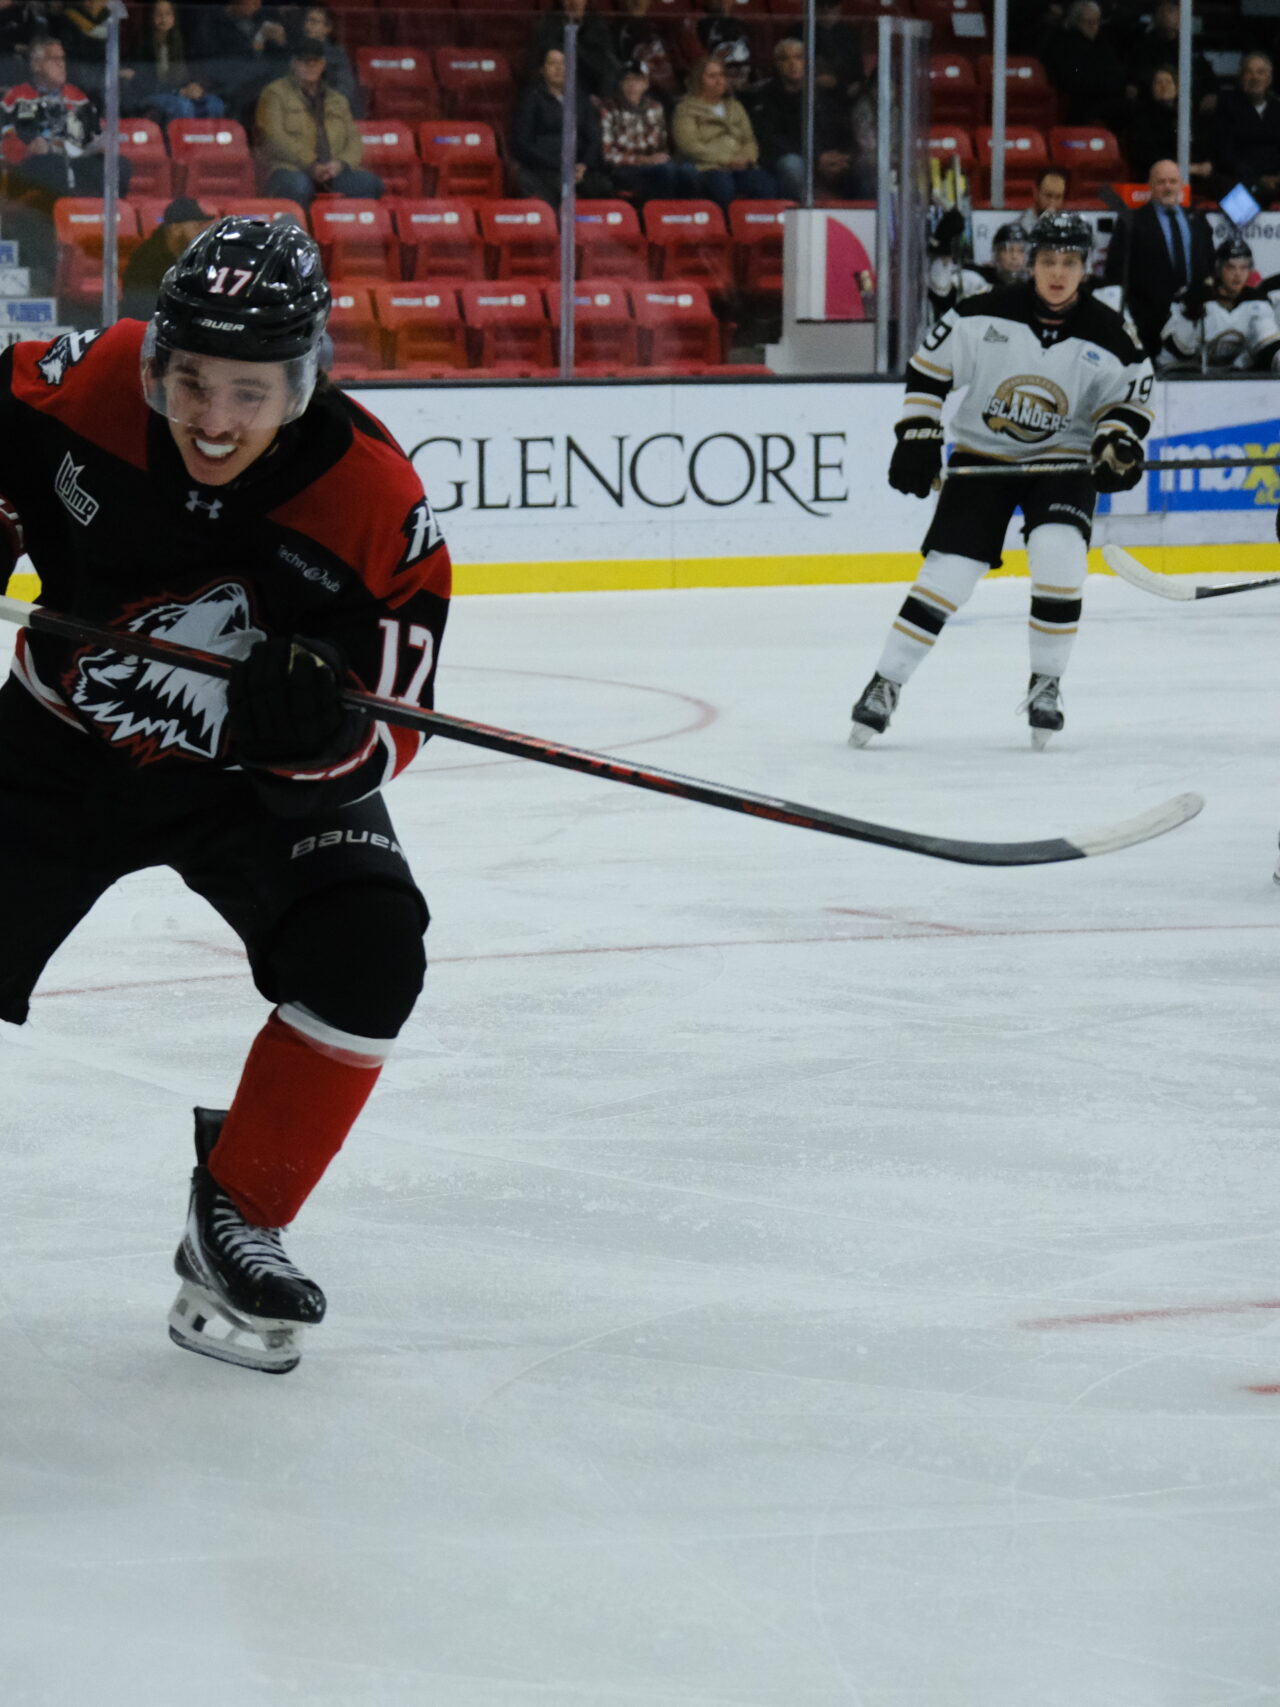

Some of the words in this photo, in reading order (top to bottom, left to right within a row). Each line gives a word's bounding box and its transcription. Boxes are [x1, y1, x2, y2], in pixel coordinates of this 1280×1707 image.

[209, 267, 253, 296] 17
[194, 317, 245, 332] AUER
[1124, 374, 1154, 404] 19
[983, 396, 1072, 433] ISLANDERS
[408, 431, 850, 518] GLENCORE
[375, 617, 434, 708] 17
